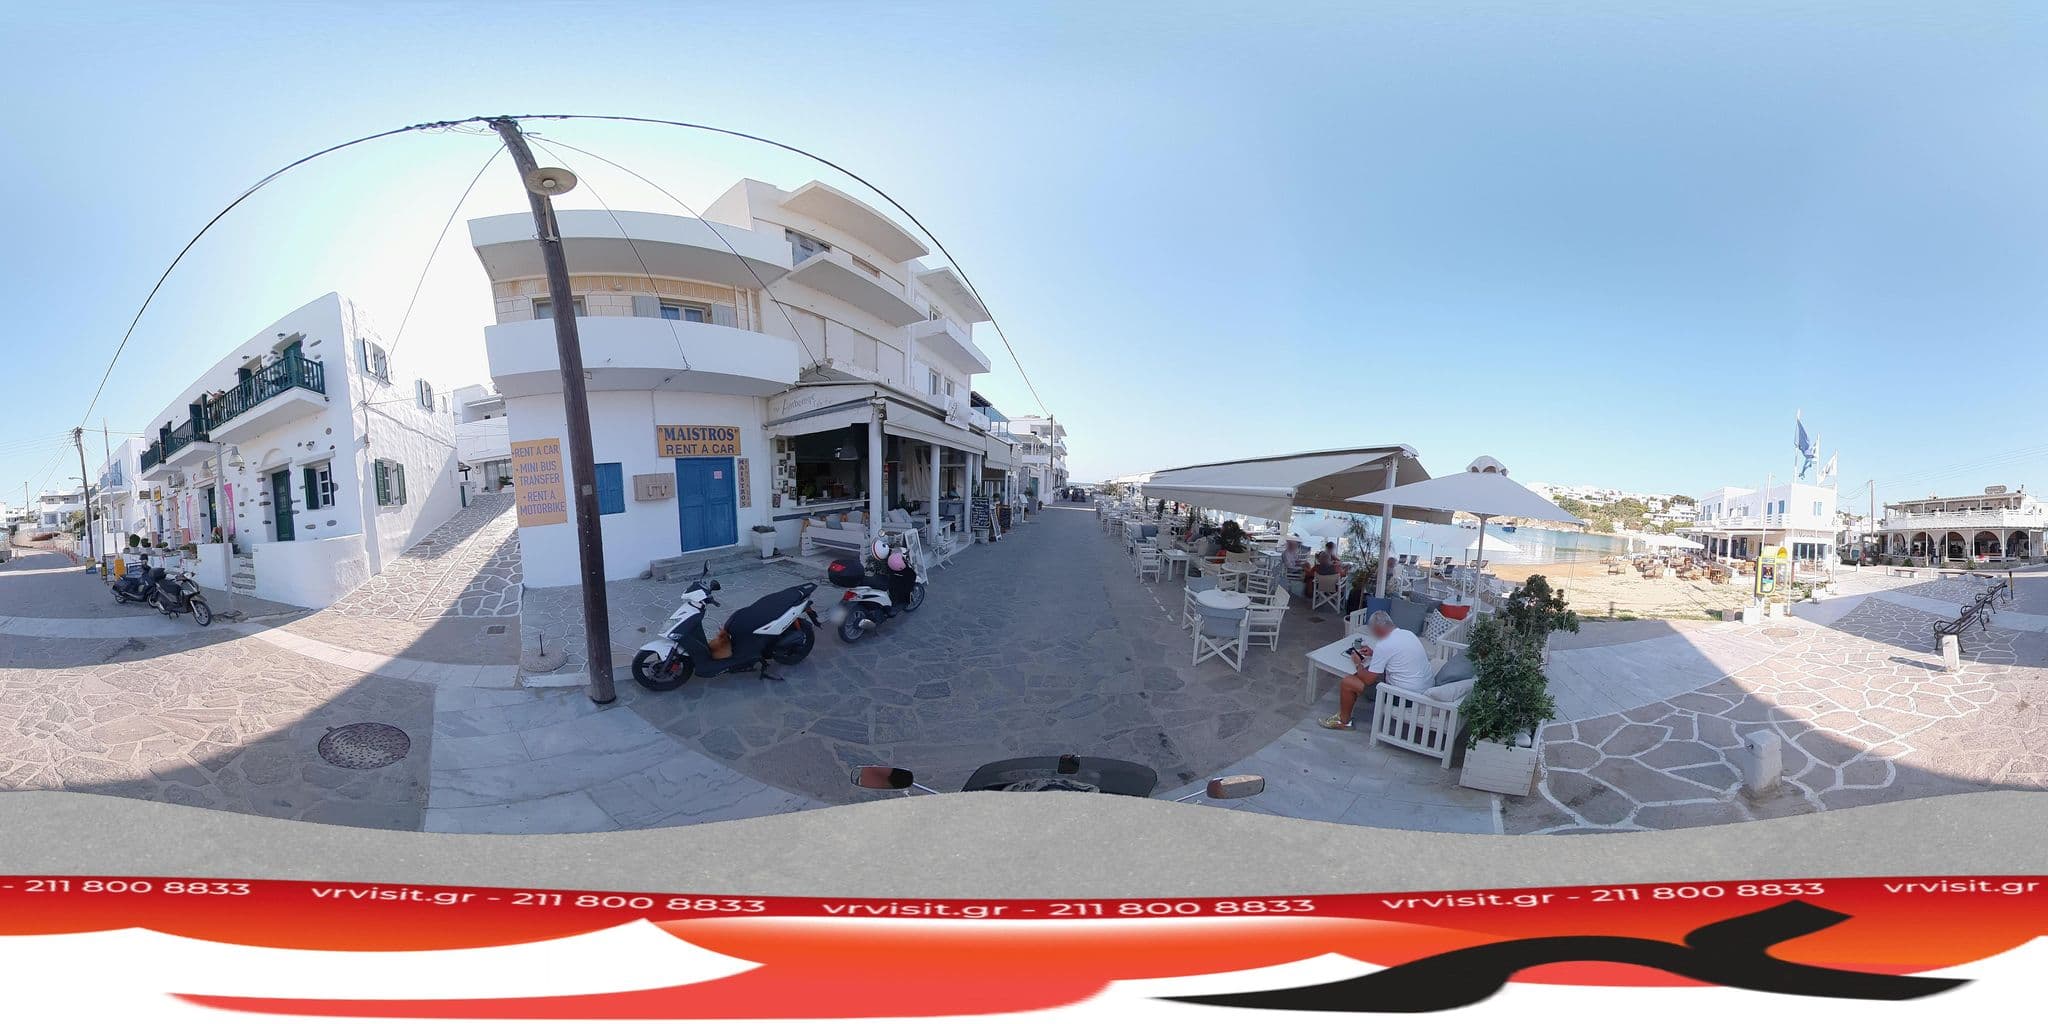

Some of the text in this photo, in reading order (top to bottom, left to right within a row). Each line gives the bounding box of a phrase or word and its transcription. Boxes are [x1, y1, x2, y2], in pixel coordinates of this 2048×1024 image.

[543, 444, 561, 455] CAR
[666, 444, 735, 454] RENT A CAR
[520, 460, 557, 473] MINI BUS
[519, 473, 560, 486] TRANSFER
[527, 489, 556, 502] RENT A
[520, 501, 566, 516] MOTORBIKE
